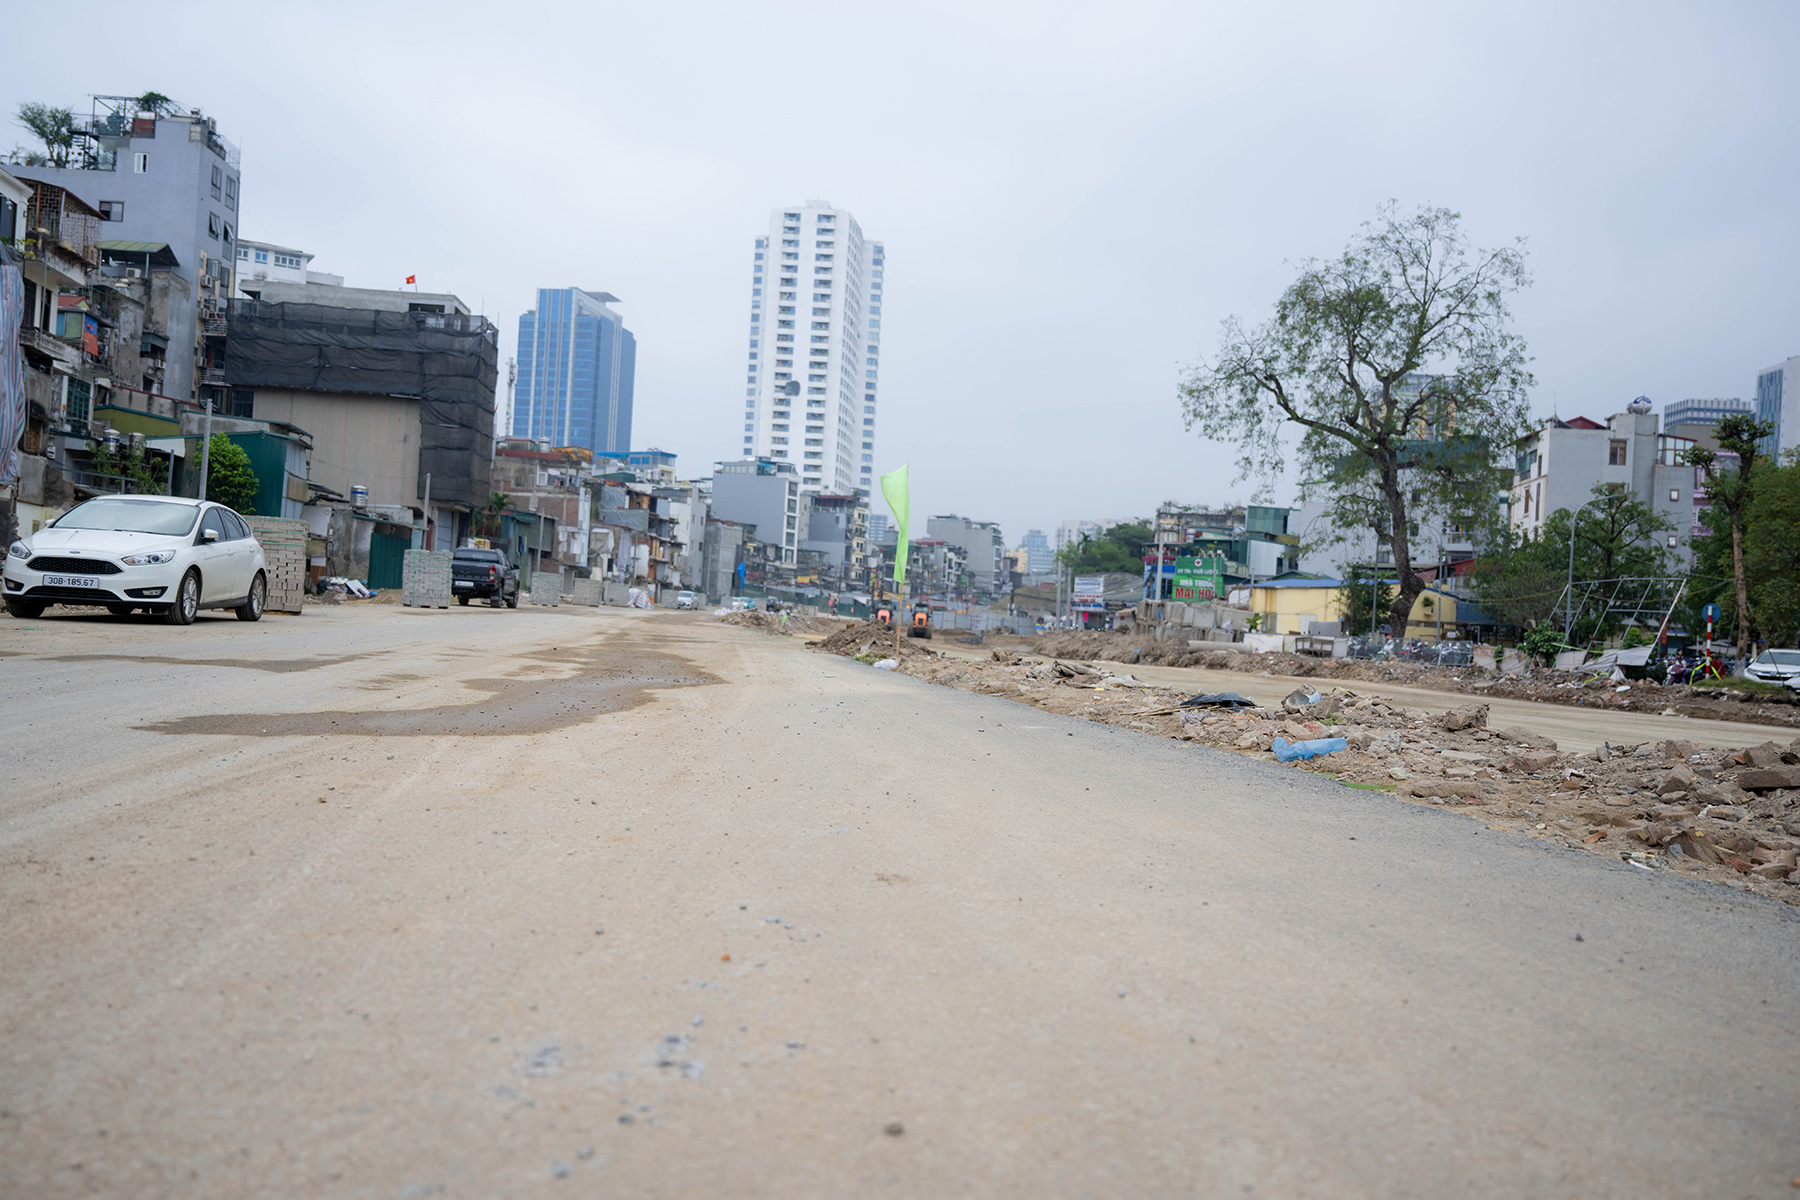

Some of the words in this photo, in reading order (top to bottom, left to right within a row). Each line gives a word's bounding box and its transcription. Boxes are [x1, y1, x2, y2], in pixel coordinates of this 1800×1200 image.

[48, 577, 94, 587] 30B-185.67
[1179, 578, 1193, 587] NHÀ
[1175, 587, 1195, 599] MAI
